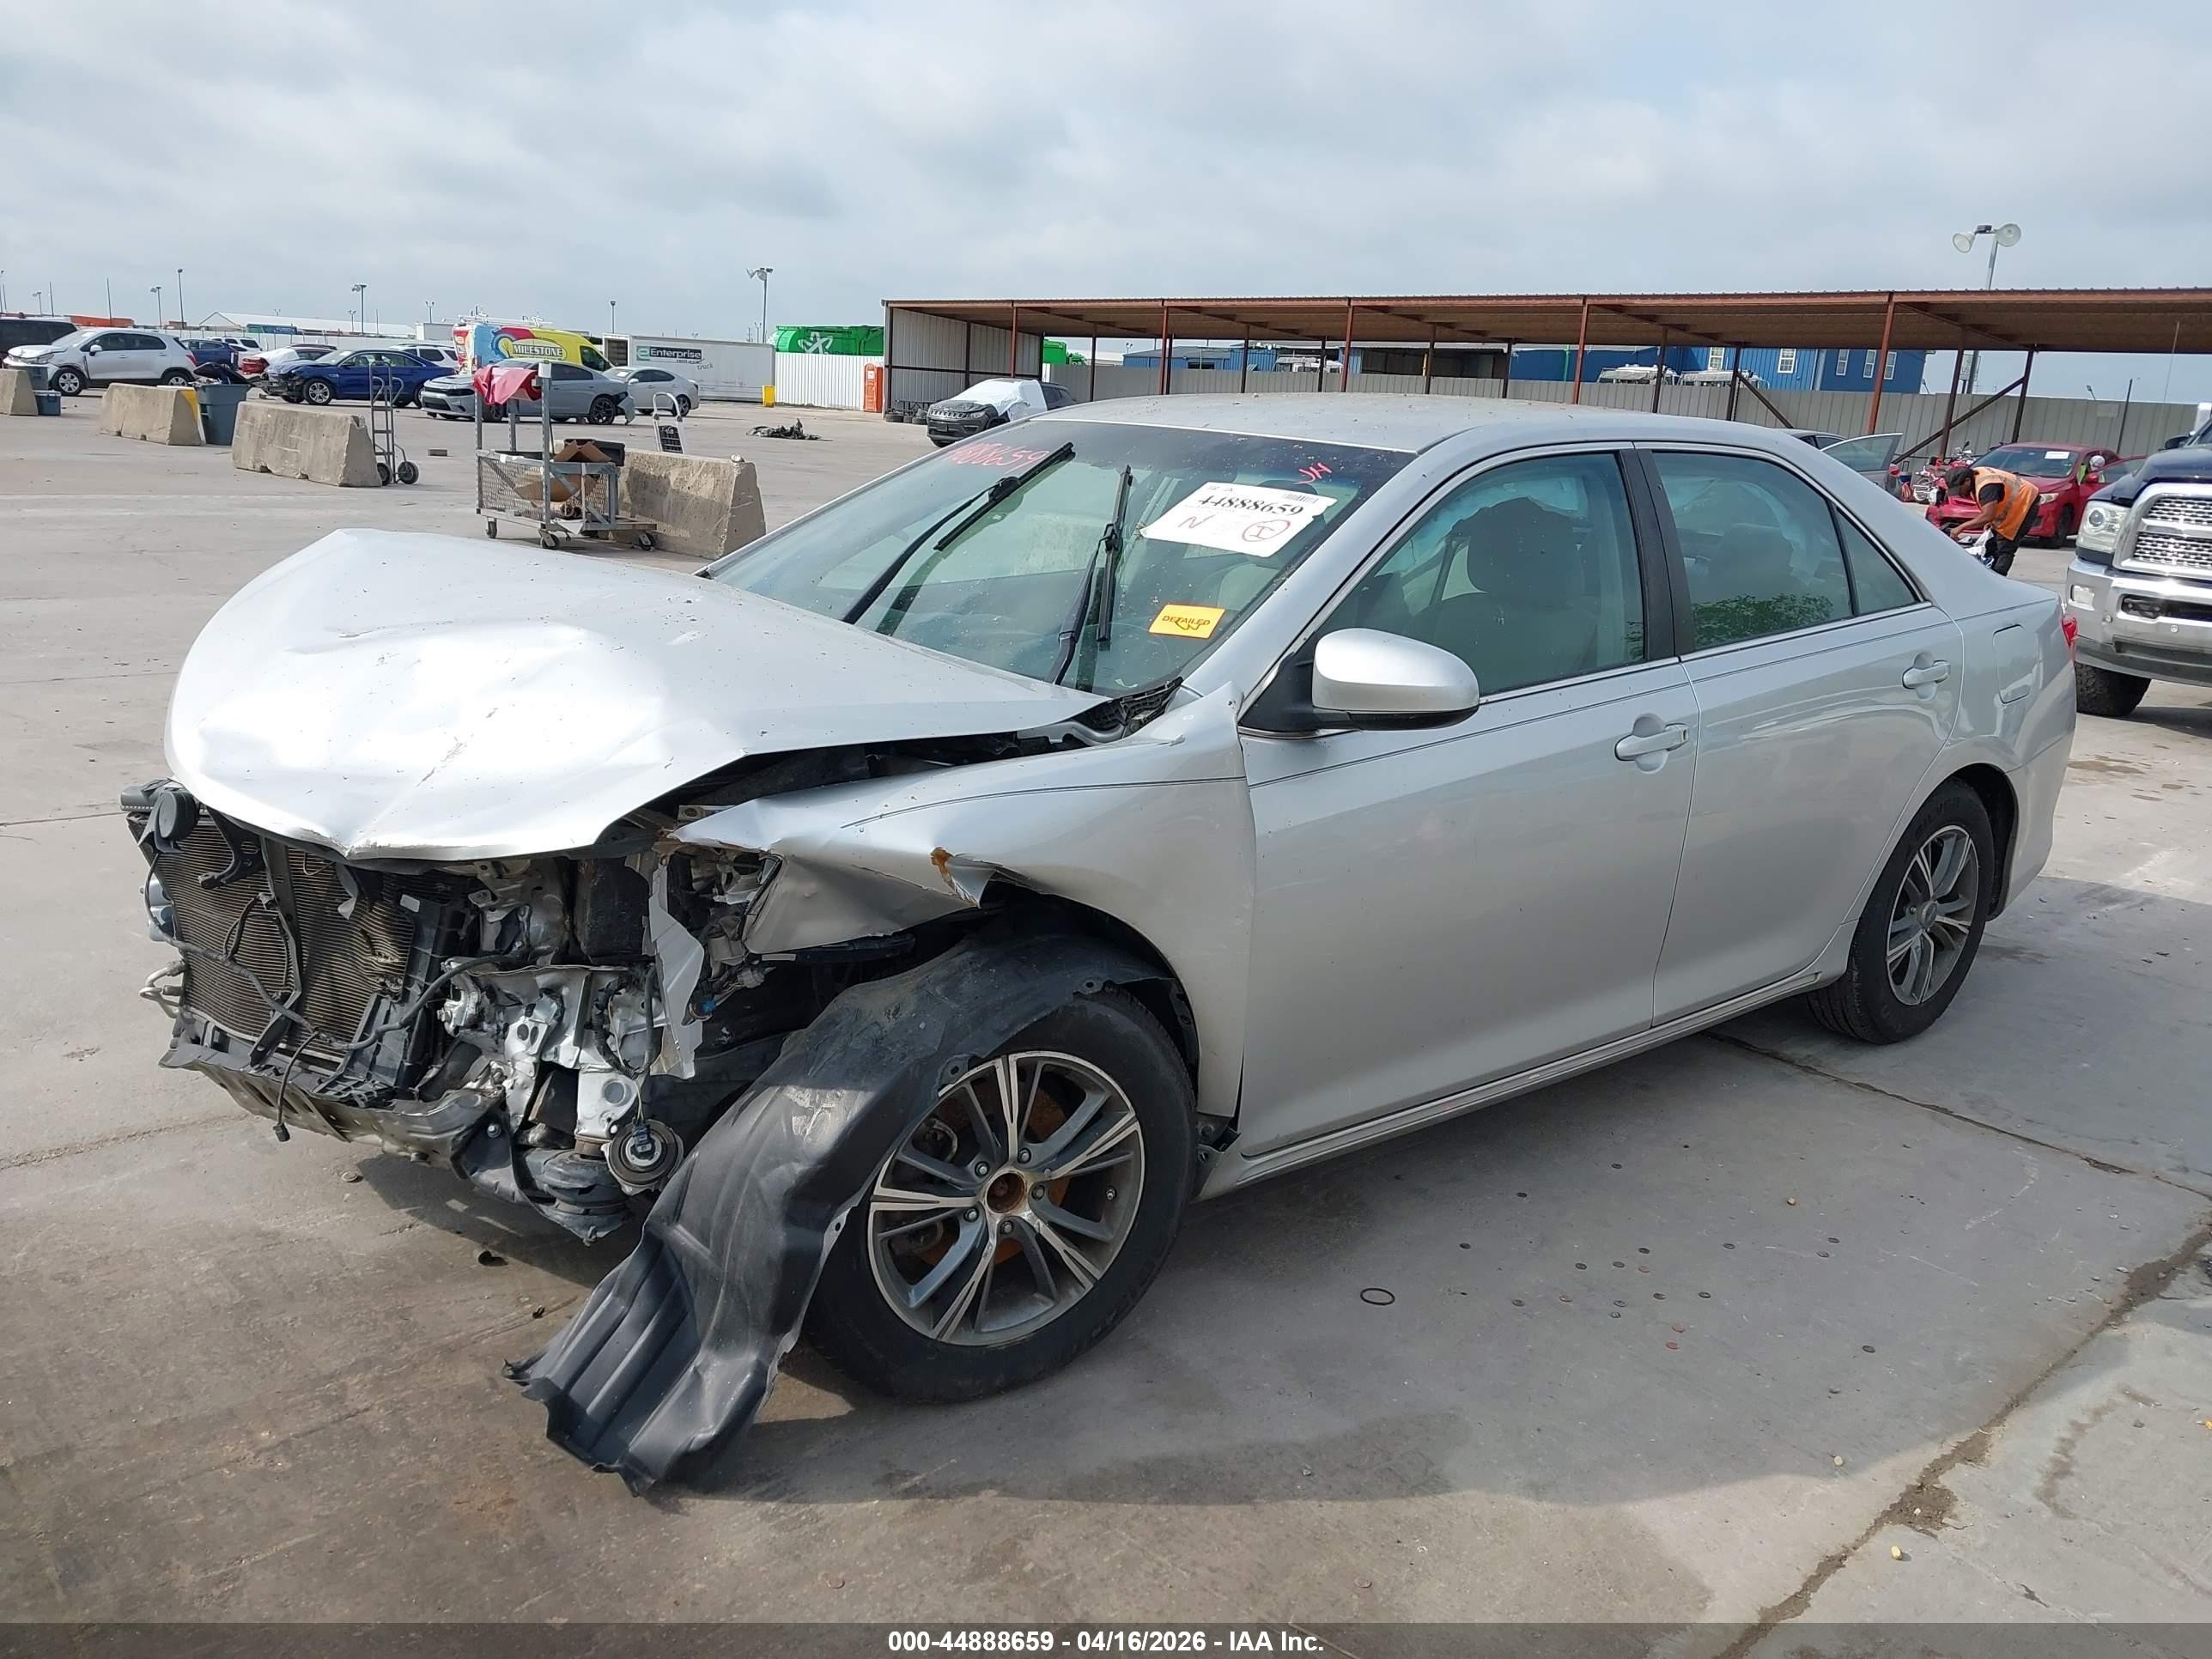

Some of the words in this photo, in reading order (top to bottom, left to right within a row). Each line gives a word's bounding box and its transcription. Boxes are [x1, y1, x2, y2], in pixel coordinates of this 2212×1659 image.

[513, 344, 562, 357] MILESTONE
[650, 348, 702, 360] Enterprise
[1198, 495, 1305, 517] 44888659
[1162, 615, 1211, 626] DETAILED
